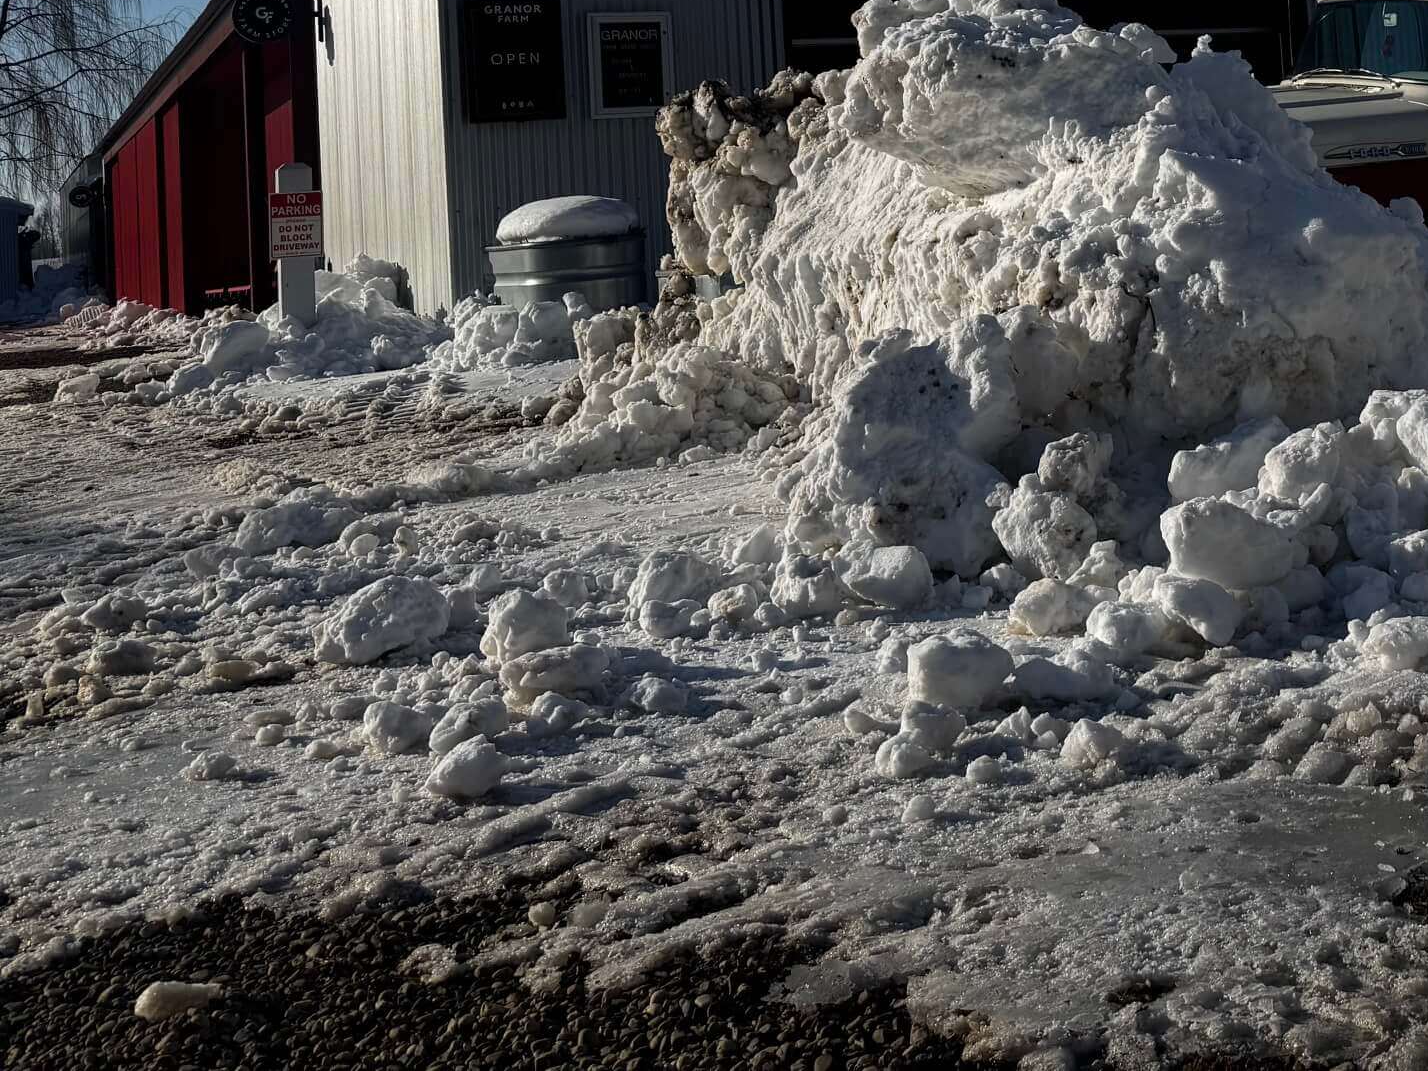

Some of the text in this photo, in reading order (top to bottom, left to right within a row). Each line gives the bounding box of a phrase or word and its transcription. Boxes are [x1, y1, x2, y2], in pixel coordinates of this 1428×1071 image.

[484, 3, 543, 15] GRANOR
[497, 14, 530, 24] FARM
[490, 52, 541, 66] OPEN
[286, 193, 307, 205] NO
[271, 204, 321, 216] PARKING
[279, 224, 314, 233] DO NOT
[280, 233, 313, 242] BLOCK
[273, 242, 320, 251] DRIVEWAY
